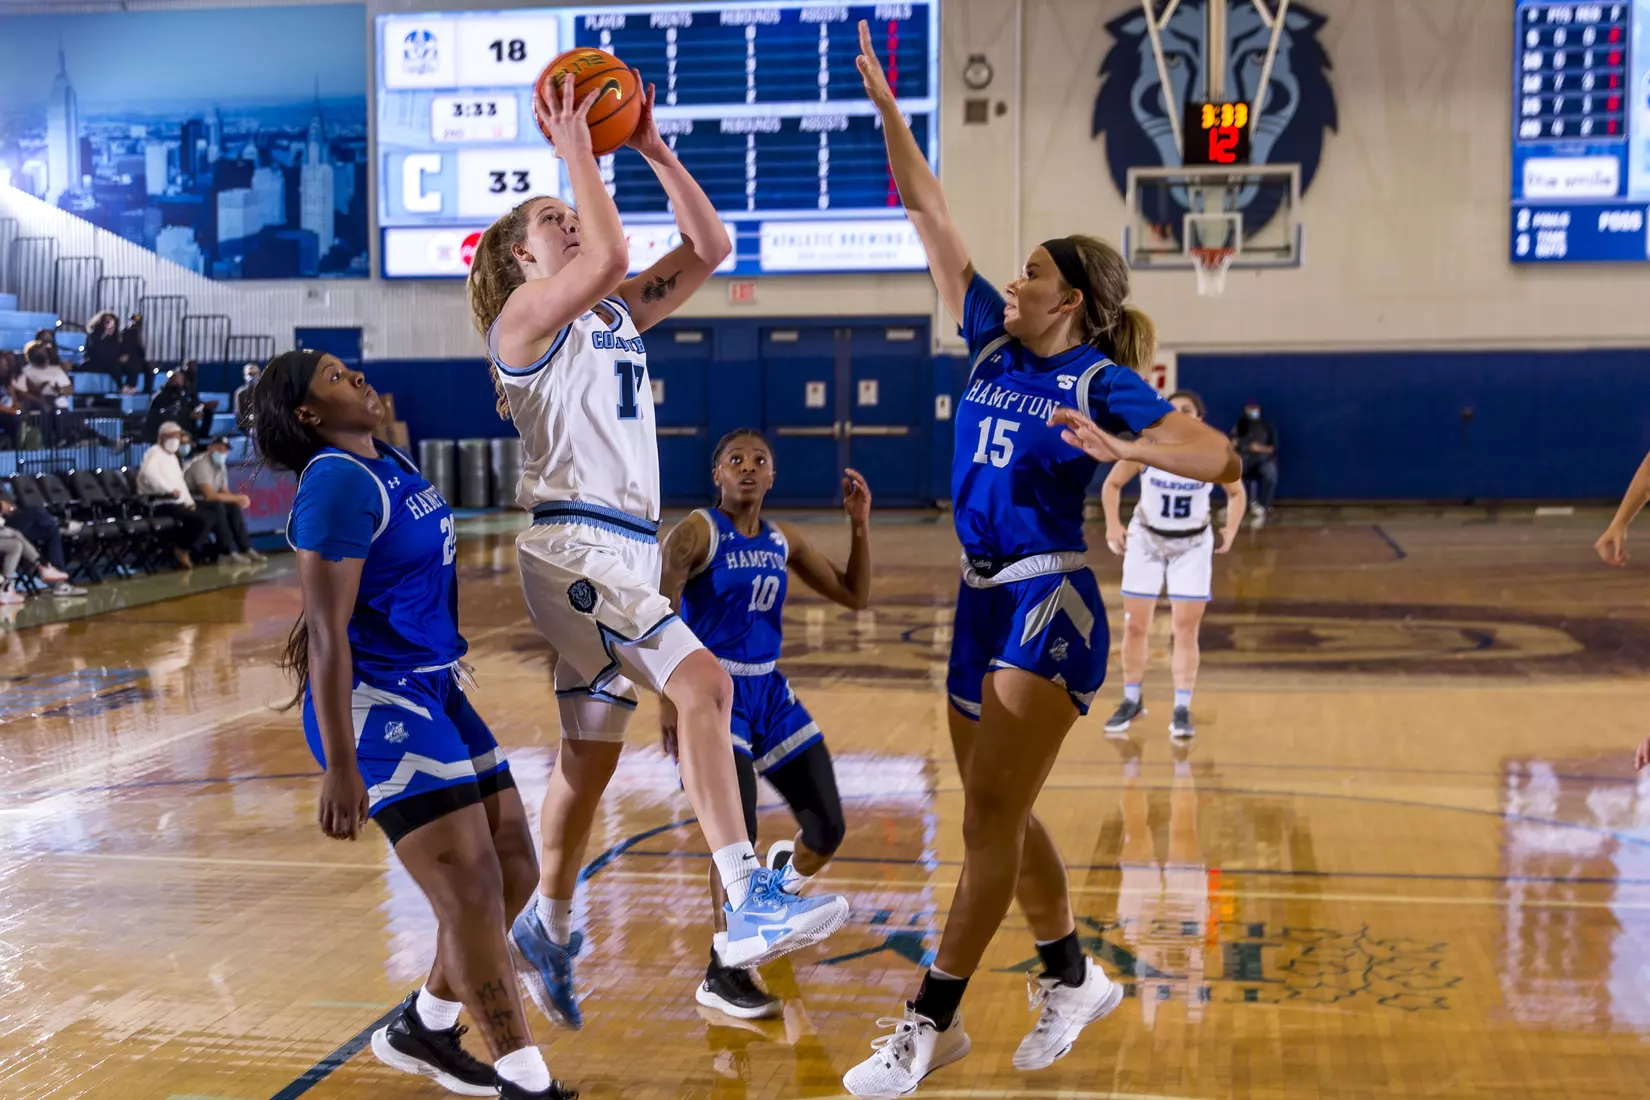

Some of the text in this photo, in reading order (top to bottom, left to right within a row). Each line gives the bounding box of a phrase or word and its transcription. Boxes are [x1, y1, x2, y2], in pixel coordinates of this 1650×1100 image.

[650, 11, 693, 28] POINTS
[489, 40, 527, 62] 18
[453, 102, 496, 117] 3:33
[1201, 103, 1249, 129] 3:33
[1209, 126, 1239, 163] 12
[403, 154, 443, 213] C
[489, 171, 530, 193] 33
[965, 378, 1060, 421] HAMPTON
[972, 416, 1021, 468] 15
[1161, 494, 1193, 519] 15
[747, 574, 780, 612] 10
